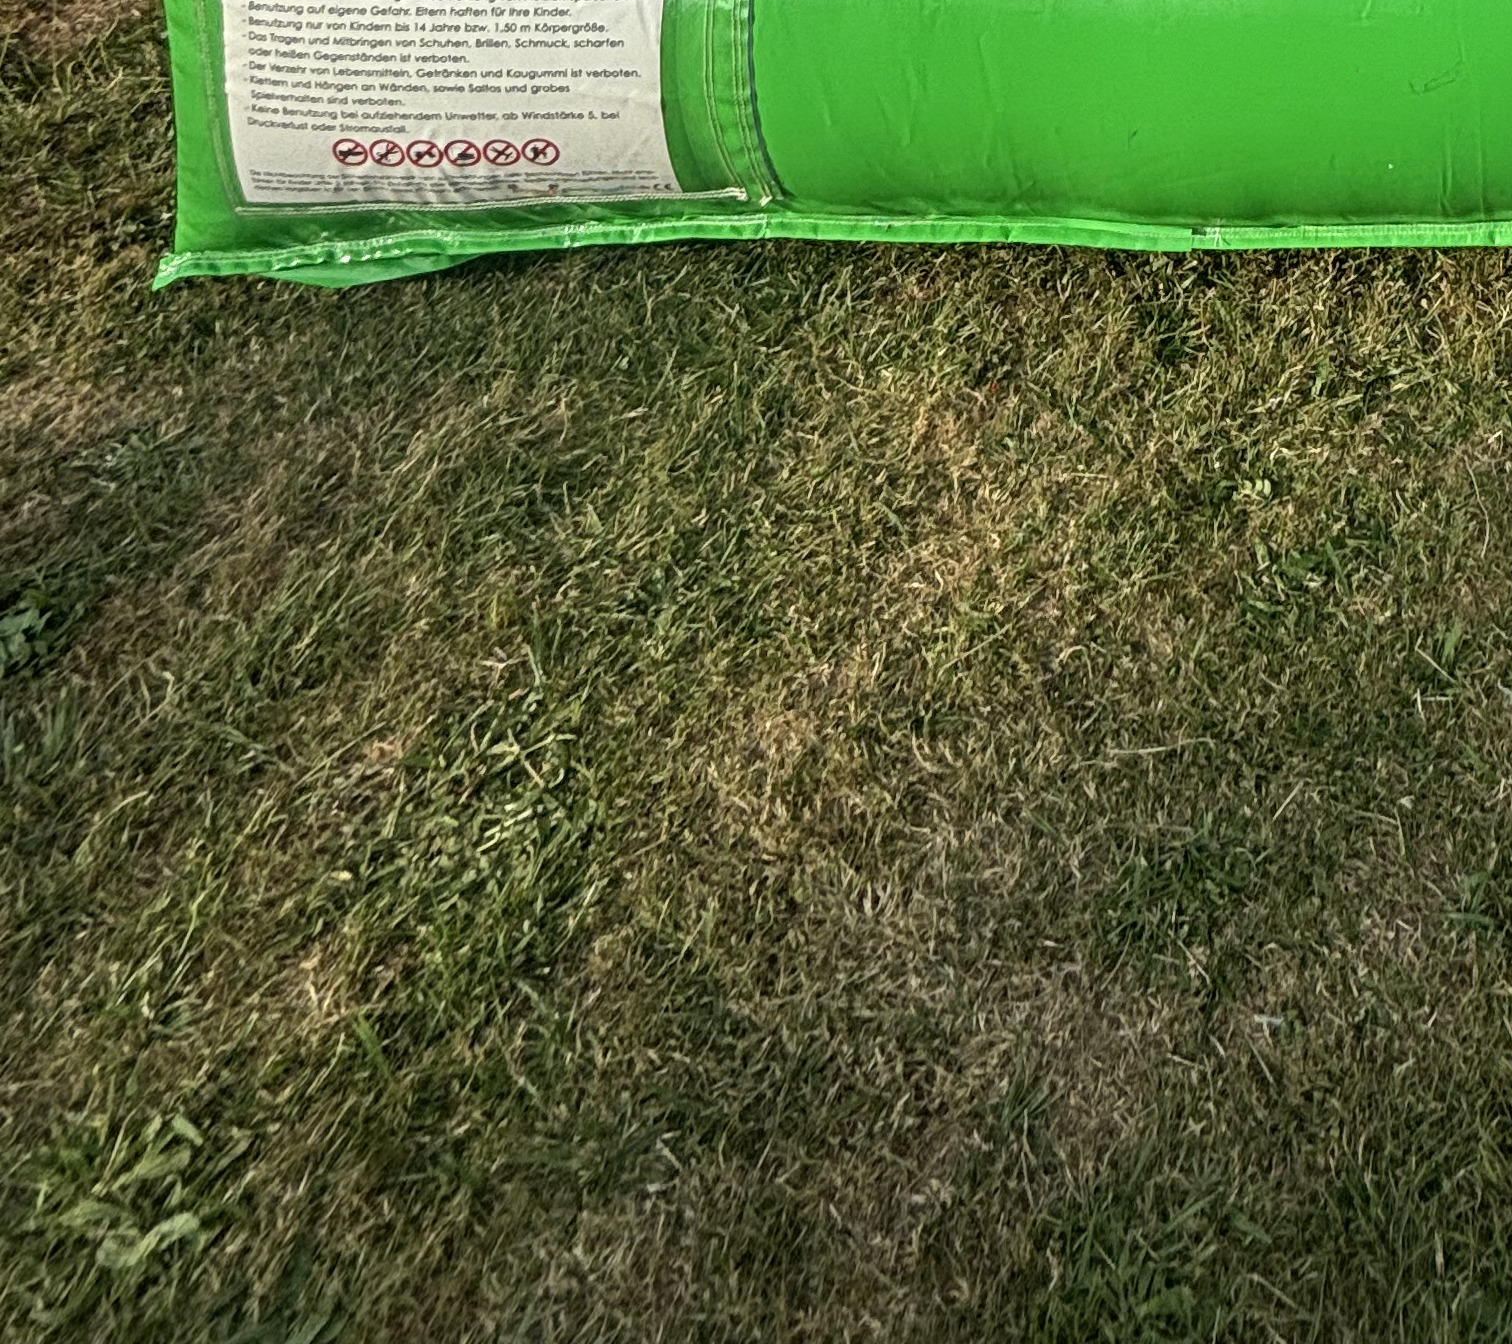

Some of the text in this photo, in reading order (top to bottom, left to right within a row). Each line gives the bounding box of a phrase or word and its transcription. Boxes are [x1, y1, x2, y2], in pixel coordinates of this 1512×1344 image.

[248, 1, 304, 15] Benutzung
[307, 5, 325, 14] auf
[328, 6, 367, 17] eigene
[451, 7, 487, 17] haften
[491, 7, 506, 17] für
[248, 16, 302, 30] Benutzung
[306, 20, 324, 29] nur
[326, 22, 346, 30] von
[350, 21, 391, 31] Kindern
[395, 22, 410, 32] bis
[414, 23, 426, 32] 14
[429, 23, 461, 33] Jahre
[520, 25, 531, 33] m
[248, 31, 267, 42] Das
[270, 33, 305, 45] Tragen
[308, 36, 330, 45] und
[333, 37, 392, 49] Mitbringen
[395, 39, 416, 48] von
[574, 39, 624, 48] scharfen
[249, 47, 272, 56] oder
[313, 51, 396, 63] Gegenständen
[400, 53, 411, 62] ist
[249, 61, 266, 70] Der
[310, 67, 330, 75] von
[416, 68, 477, 78] Getränken
[480, 69, 503, 78] und
[506, 69, 568, 80] Kaugummi
[571, 69, 582, 78] ist
[291, 79, 311, 89] und
[315, 81, 358, 92] Hängen
[505, 84, 527, 93] und
[531, 84, 570, 94] grobes
[327, 95, 348, 105] sind
[251, 104, 280, 114] Keine
[282, 107, 337, 120] Benutzung
[502, 112, 518, 120] ab
[522, 111, 584, 120] Windstärke
[311, 123, 336, 131] oder
